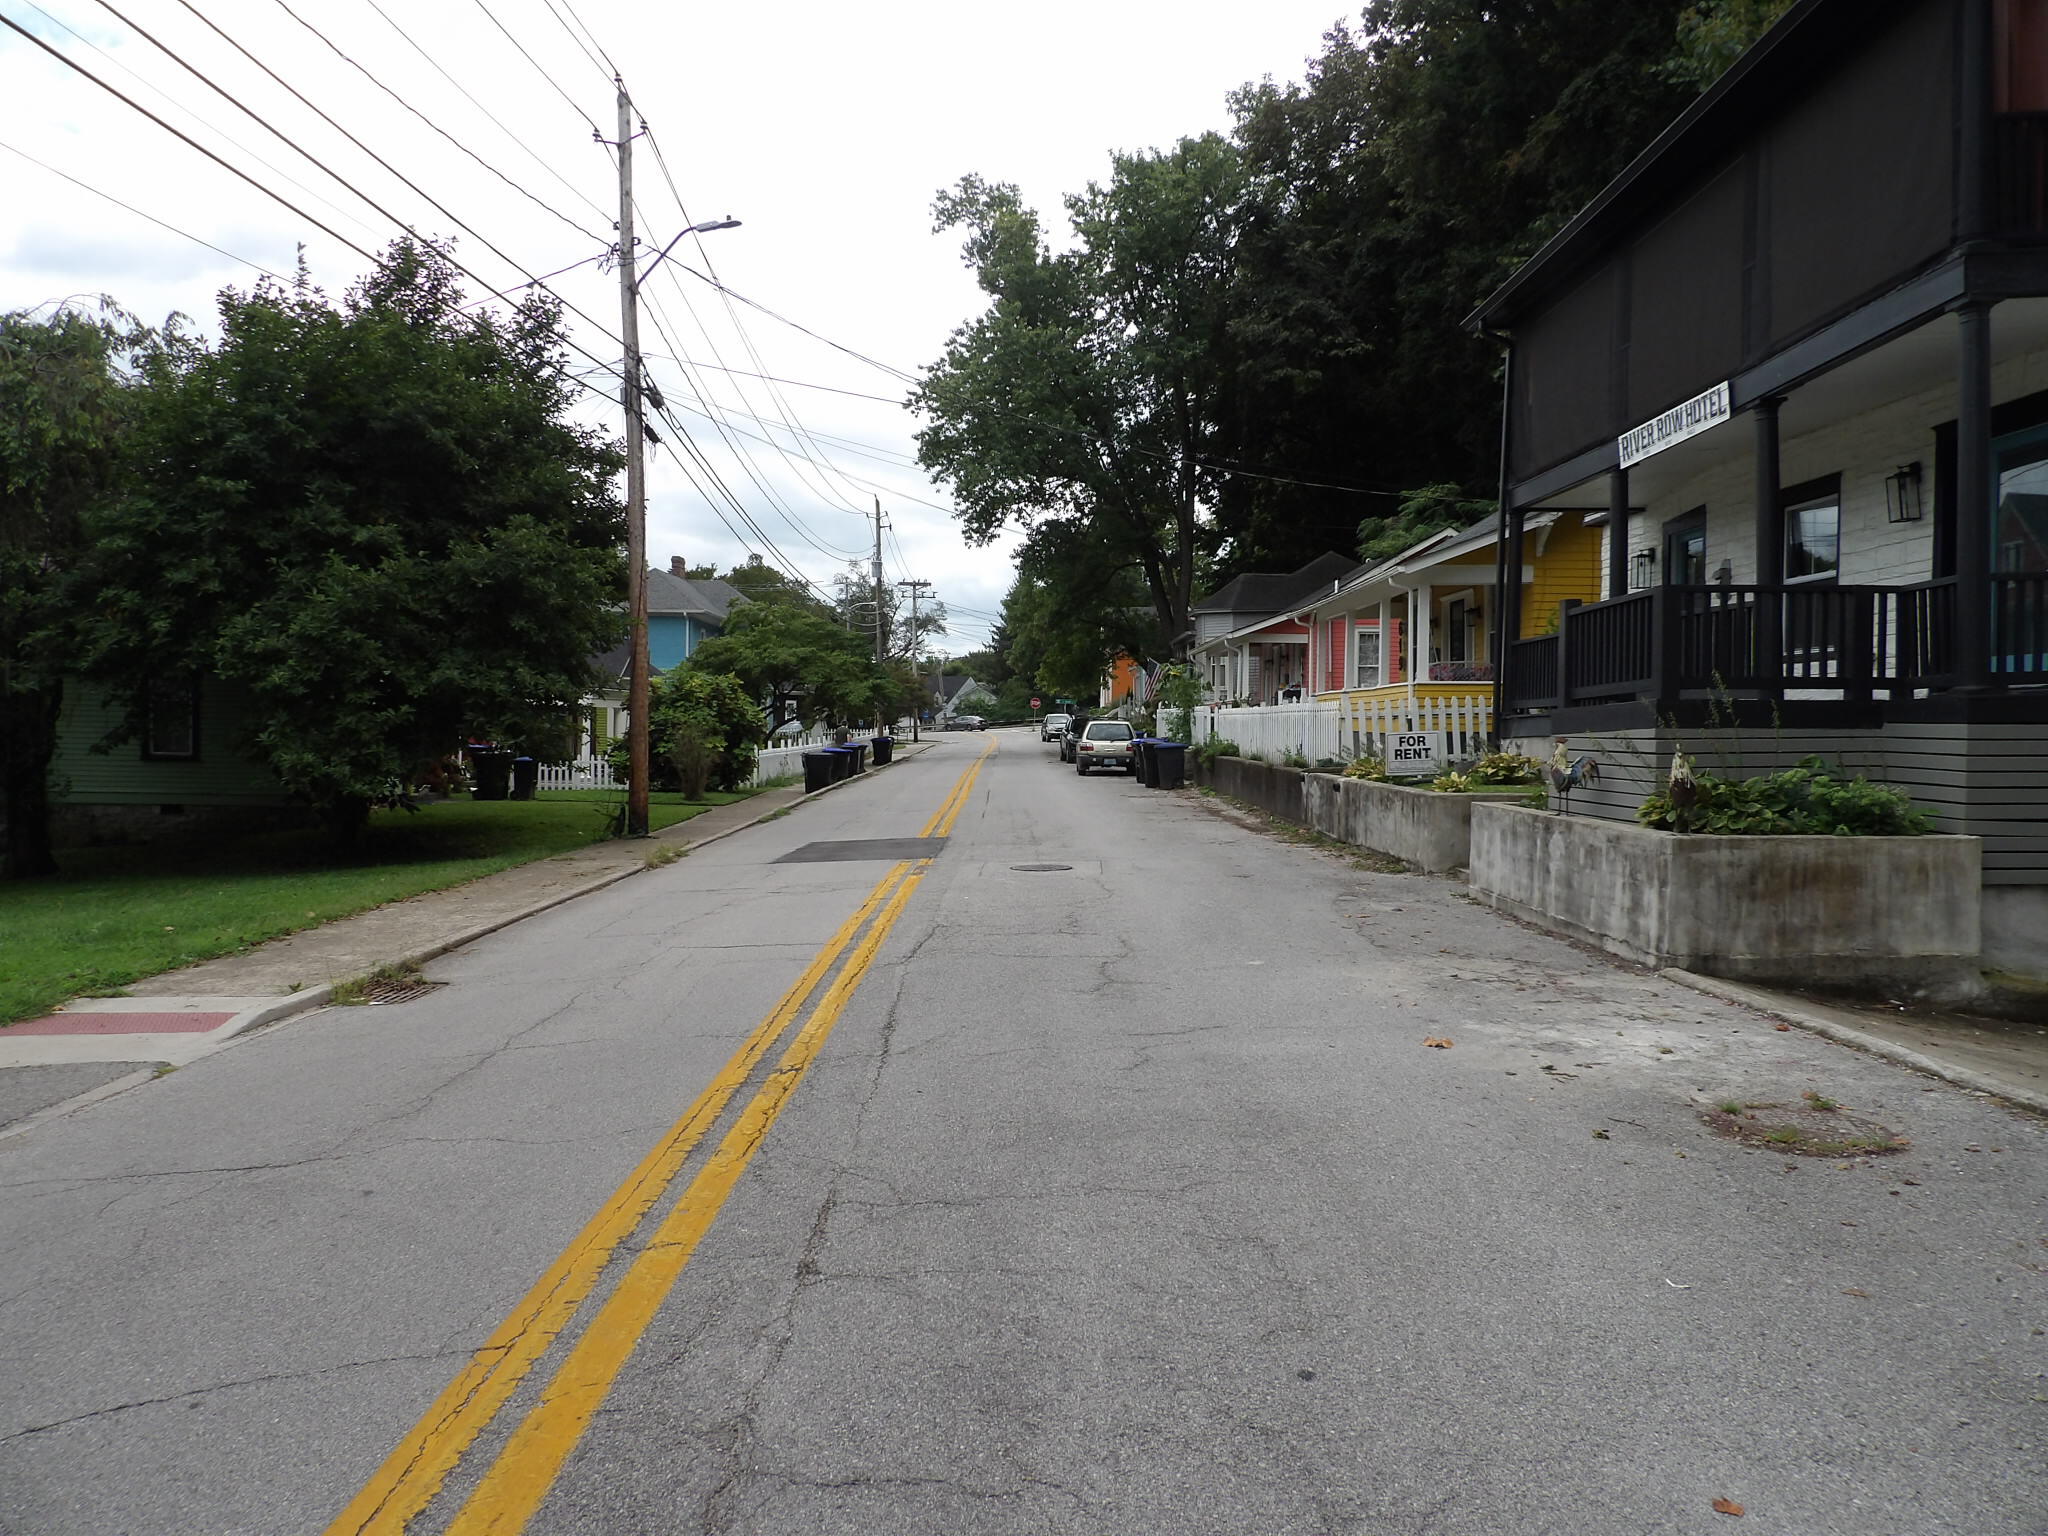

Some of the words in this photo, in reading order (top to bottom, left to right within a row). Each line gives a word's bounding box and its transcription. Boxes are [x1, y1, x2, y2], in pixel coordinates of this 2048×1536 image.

[1621, 423, 1655, 462] RIVER
[1656, 405, 1685, 441] ROW
[1685, 387, 1727, 428] HOTEL
[1399, 736, 1426, 747] FOR
[1394, 748, 1431, 760] RENT
